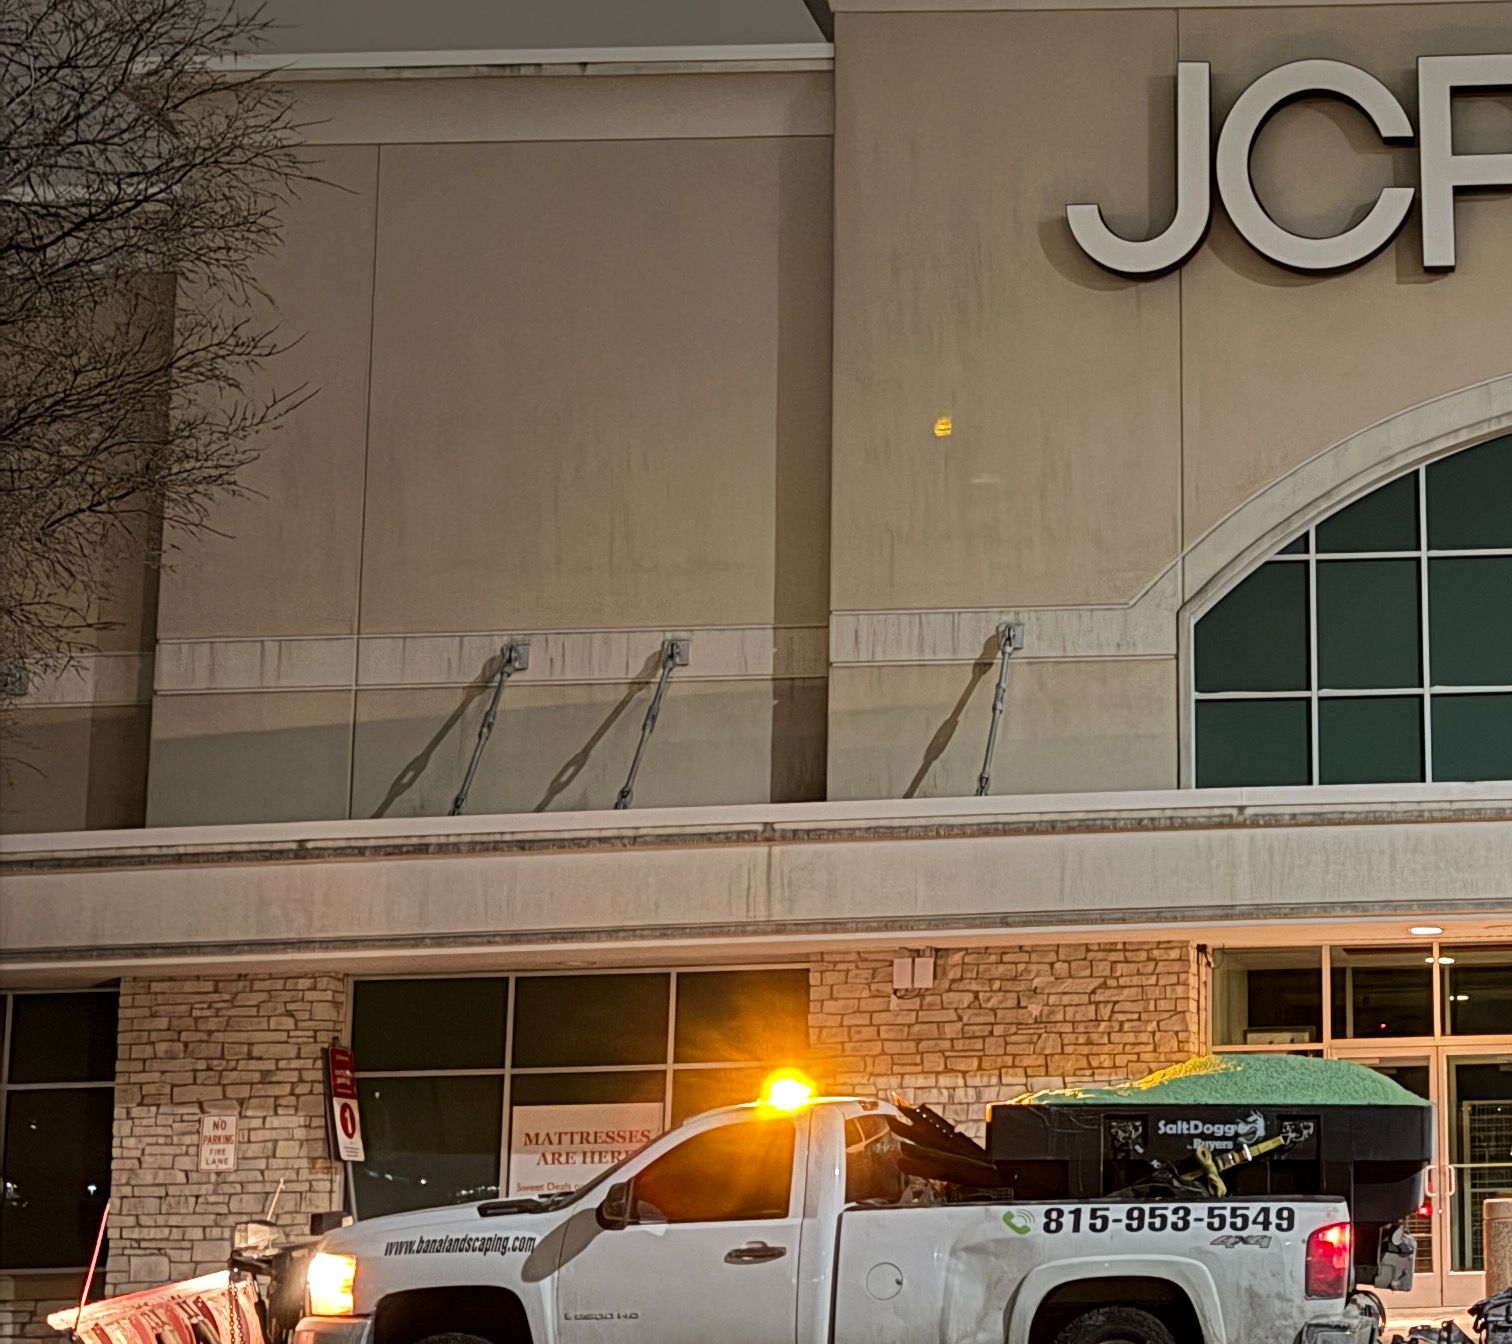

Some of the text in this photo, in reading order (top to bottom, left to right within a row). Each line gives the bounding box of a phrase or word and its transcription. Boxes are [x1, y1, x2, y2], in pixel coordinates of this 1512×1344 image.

[213, 1119, 227, 1131] NO
[1158, 1120, 1236, 1136] SaltDogg
[202, 1135, 235, 1145] PARKING
[524, 1129, 651, 1146] MATTRESSES
[210, 1148, 226, 1156] FIRE
[536, 1151, 577, 1166] ARE
[206, 1158, 228, 1166] LANE
[1043, 1206, 1295, 1234] 815-953-5549
[384, 1233, 536, 1257] www.banalandscaping.com
